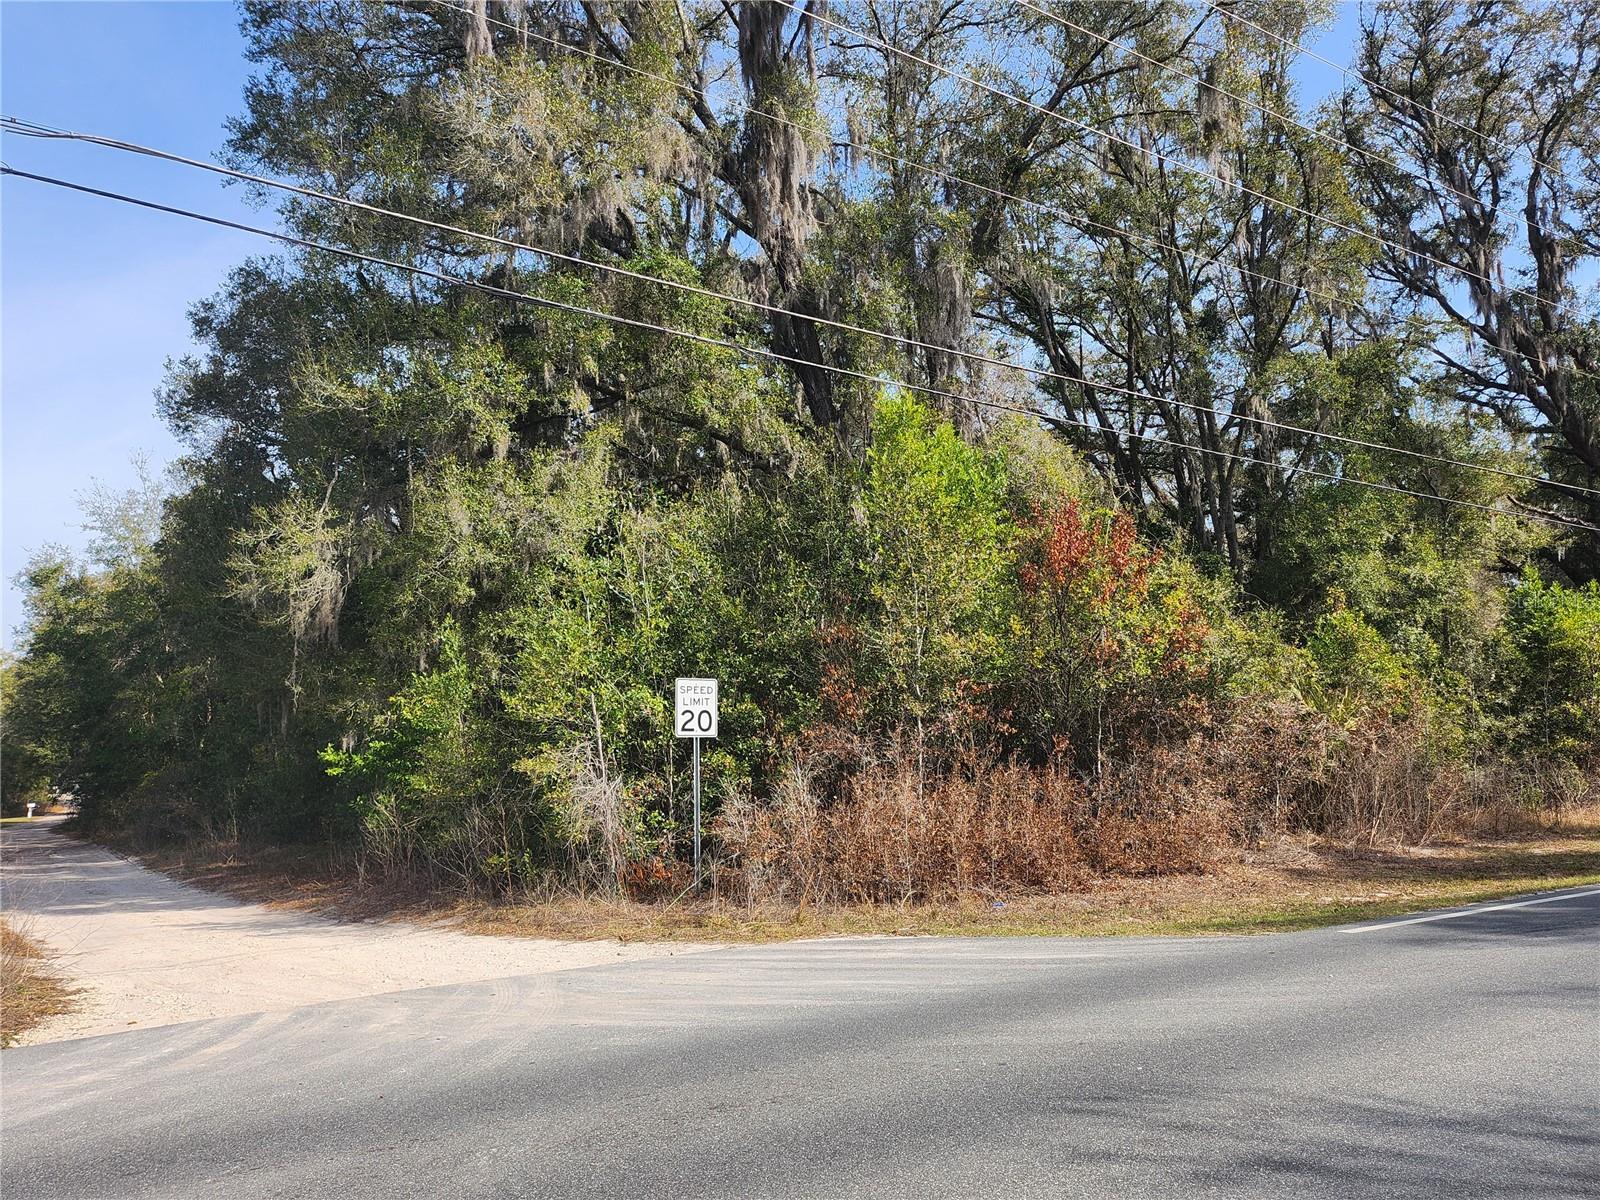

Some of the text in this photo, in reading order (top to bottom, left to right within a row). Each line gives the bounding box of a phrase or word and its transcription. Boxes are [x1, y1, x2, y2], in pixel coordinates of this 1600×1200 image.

[680, 685, 713, 694] SPEED
[683, 697, 710, 706] LIMIT
[681, 710, 712, 732] 20
